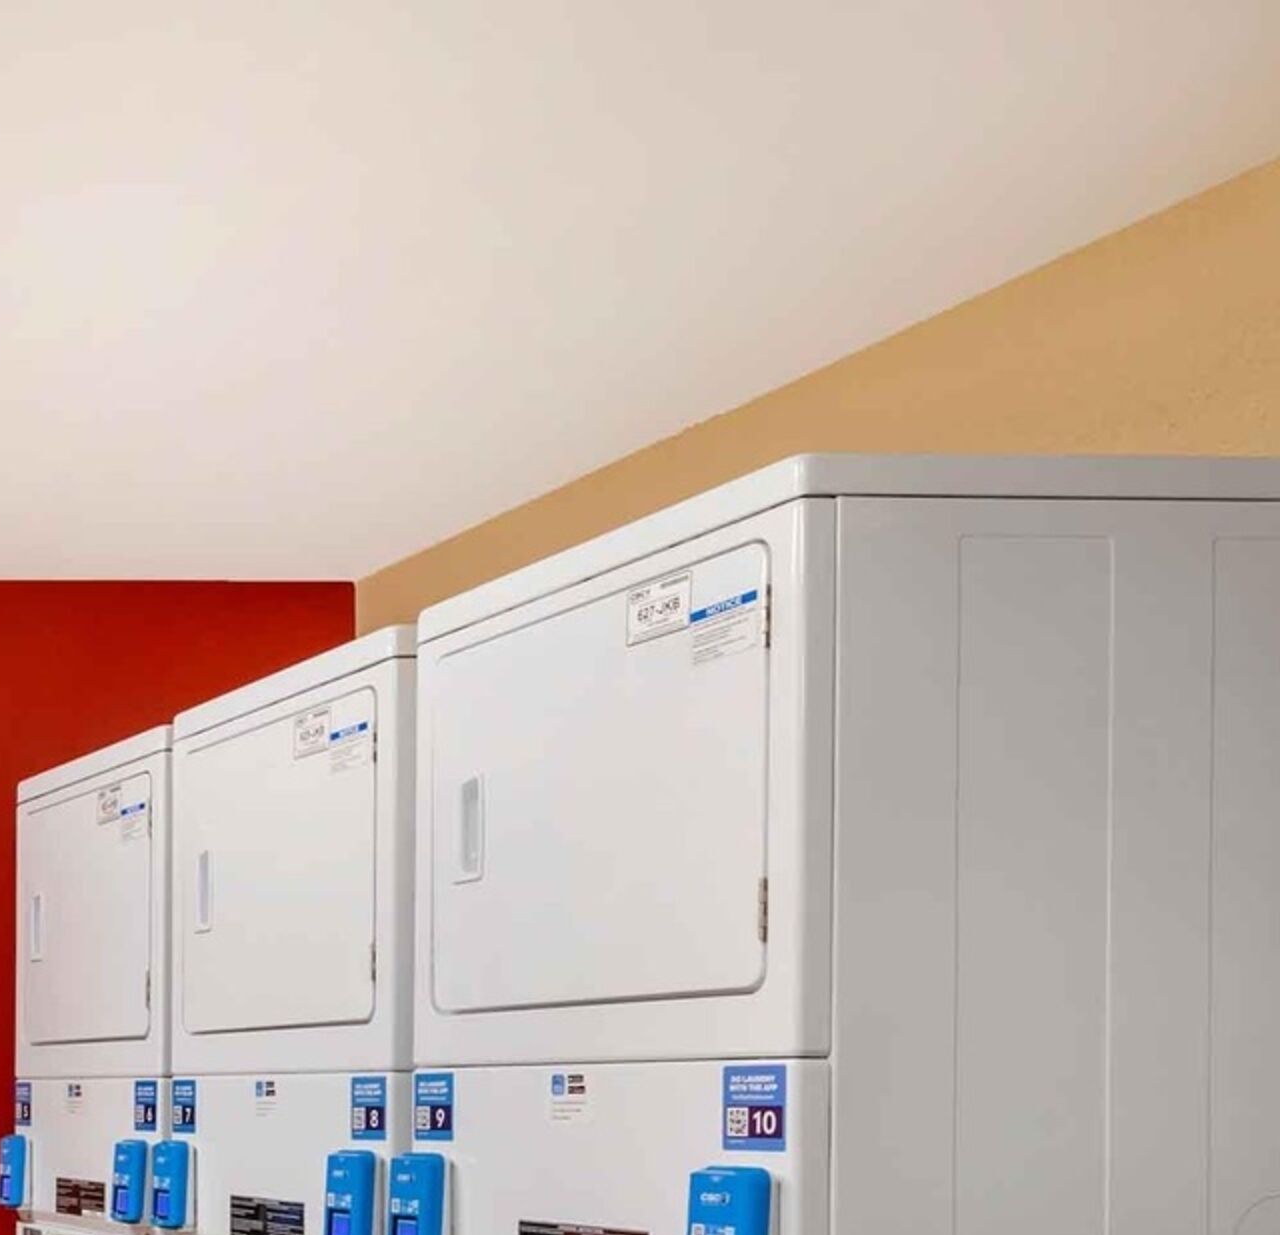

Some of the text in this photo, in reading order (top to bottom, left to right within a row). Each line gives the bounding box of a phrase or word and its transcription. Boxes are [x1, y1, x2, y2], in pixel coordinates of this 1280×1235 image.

[185, 1108, 191, 1122] 7
[370, 1109, 379, 1128] 8
[436, 1108, 445, 1128] 9
[752, 1110, 777, 1135] 10
